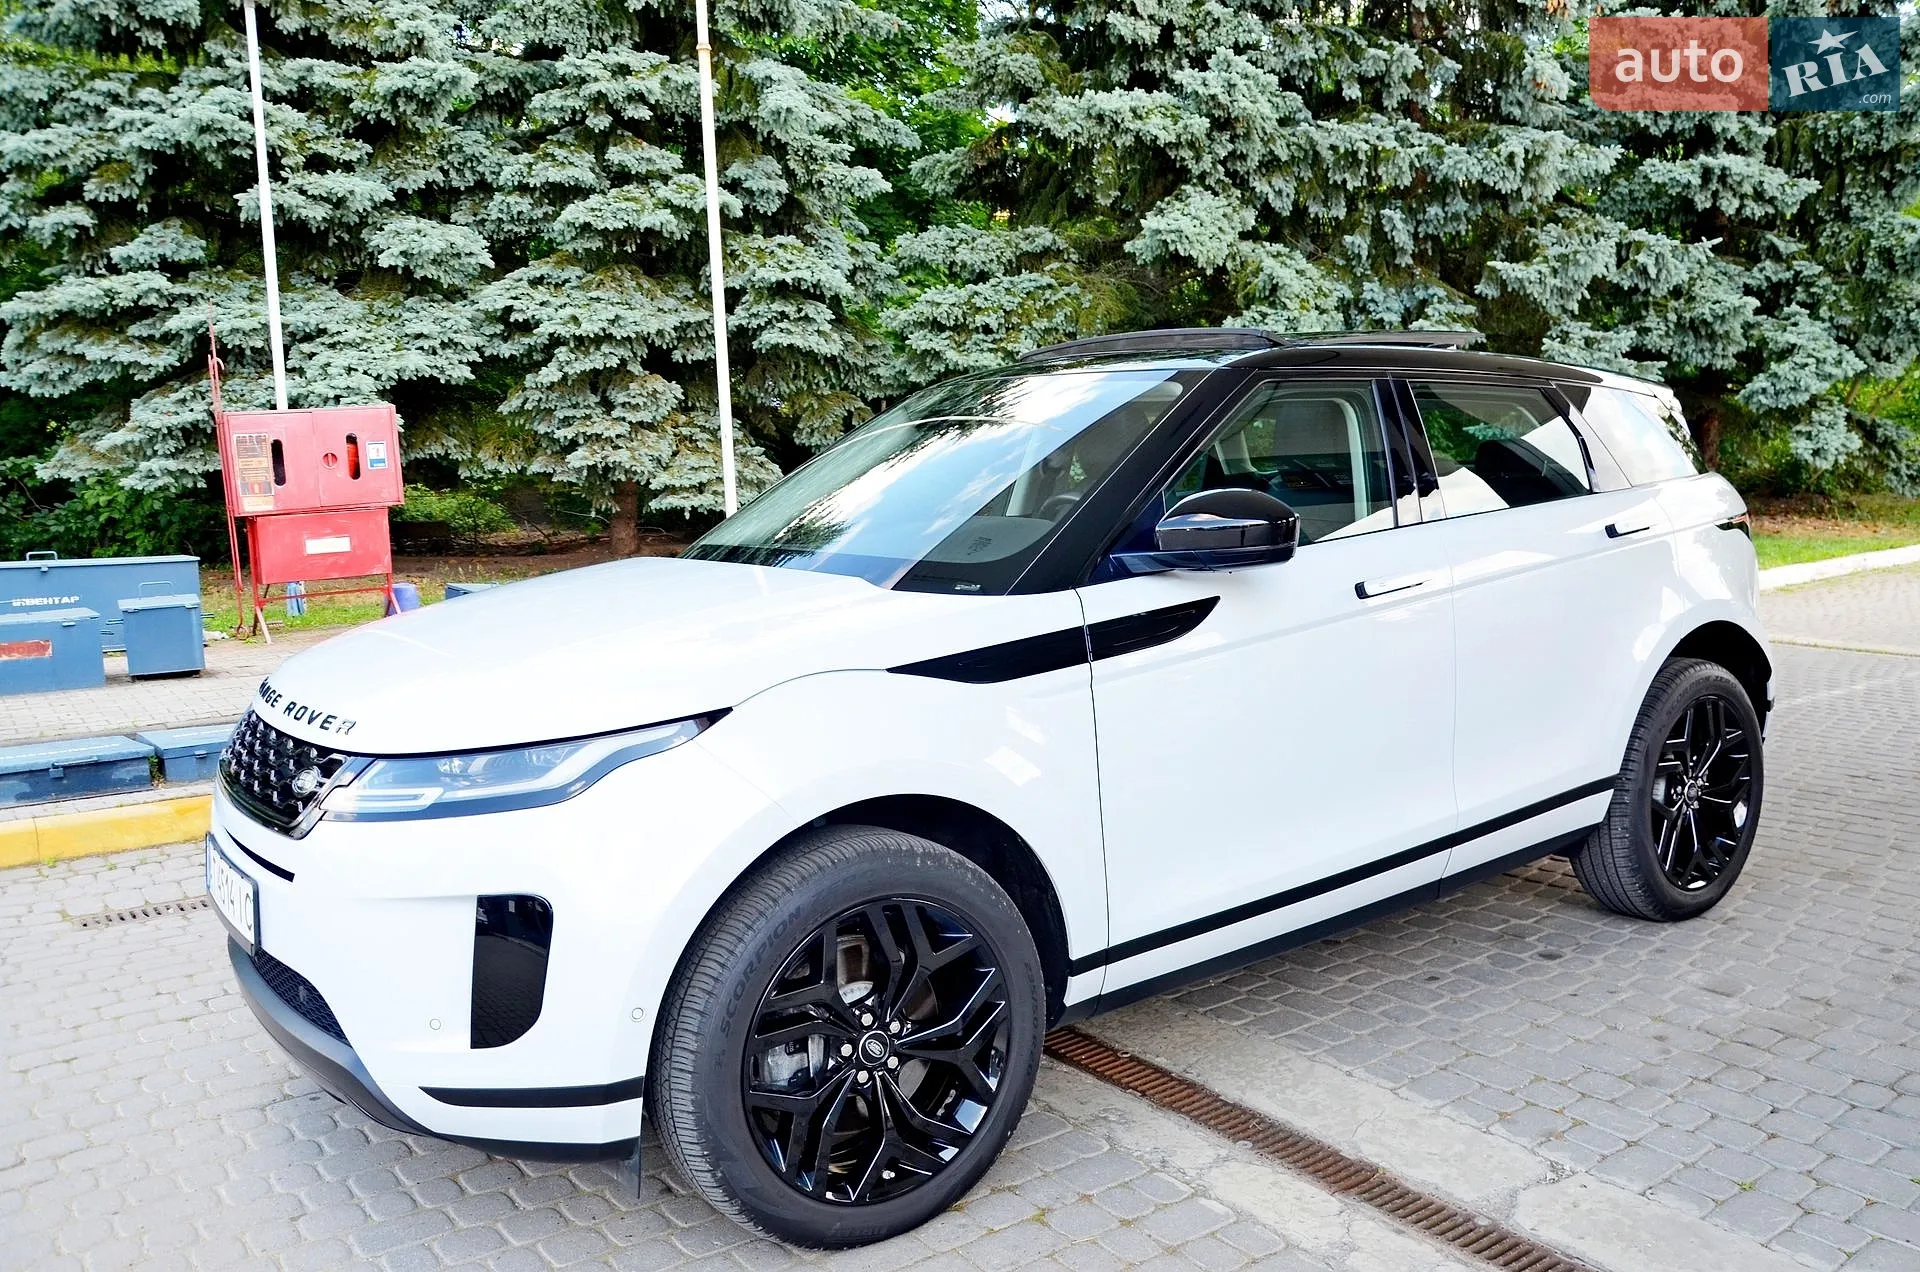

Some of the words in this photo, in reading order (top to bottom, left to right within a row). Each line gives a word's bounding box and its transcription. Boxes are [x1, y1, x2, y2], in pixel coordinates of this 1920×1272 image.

[258, 675, 283, 708] ANGE
[283, 701, 357, 736] ROVER
[720, 903, 806, 1038] SCORPION
